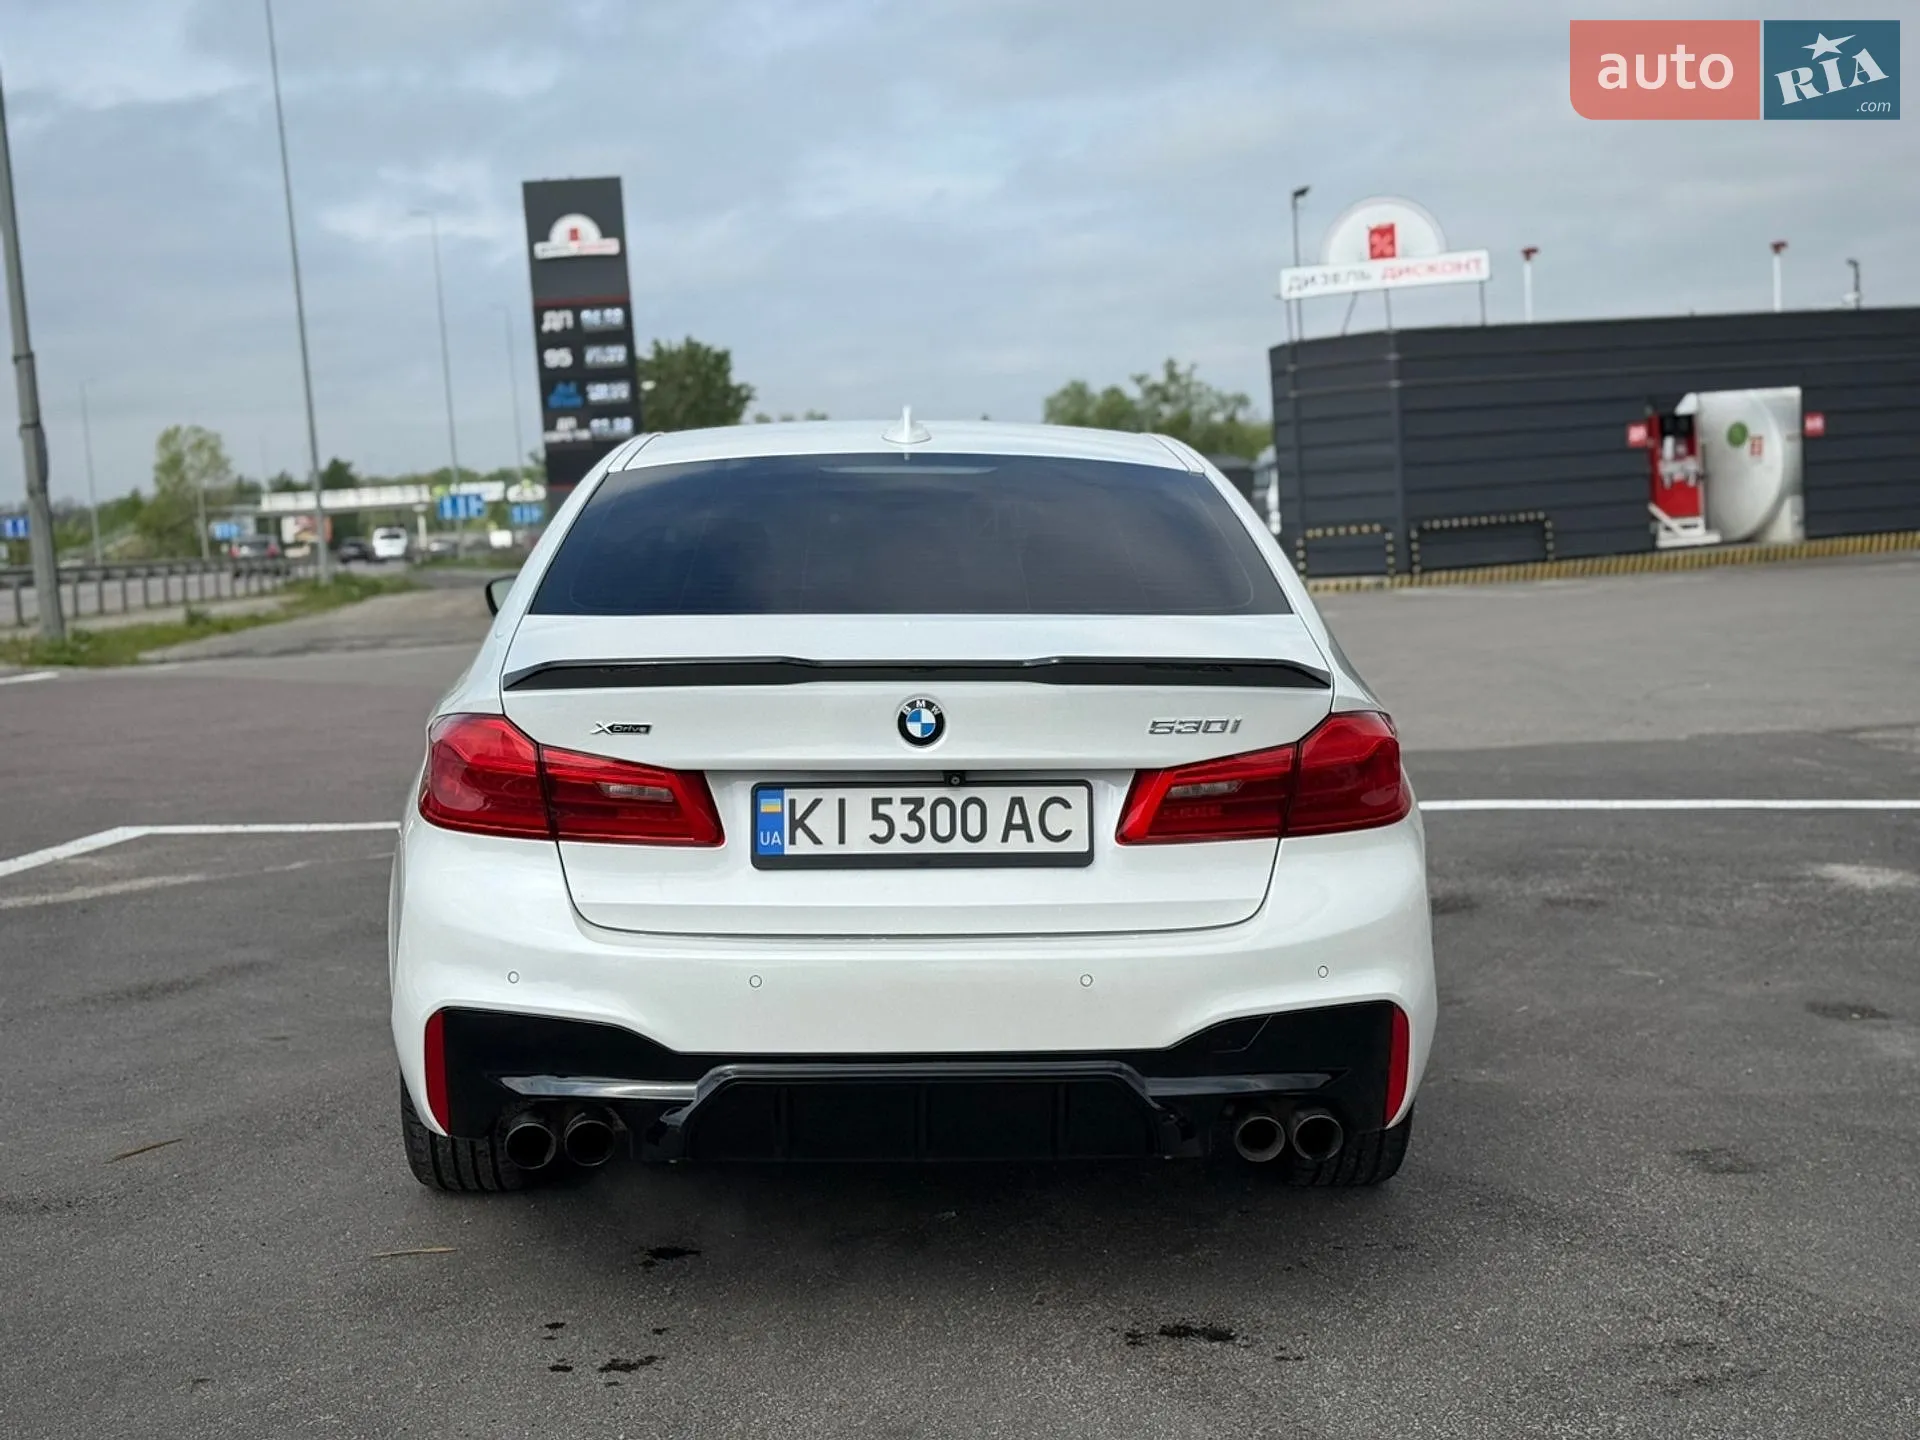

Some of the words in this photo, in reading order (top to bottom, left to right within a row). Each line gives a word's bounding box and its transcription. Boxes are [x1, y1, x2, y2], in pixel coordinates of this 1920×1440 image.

[1381, 257, 1482, 282] ДИСКОНТ
[788, 797, 846, 846] KI
[868, 796, 988, 845] 5300
[1000, 796, 1073, 843] AC
[759, 830, 782, 846] UA
